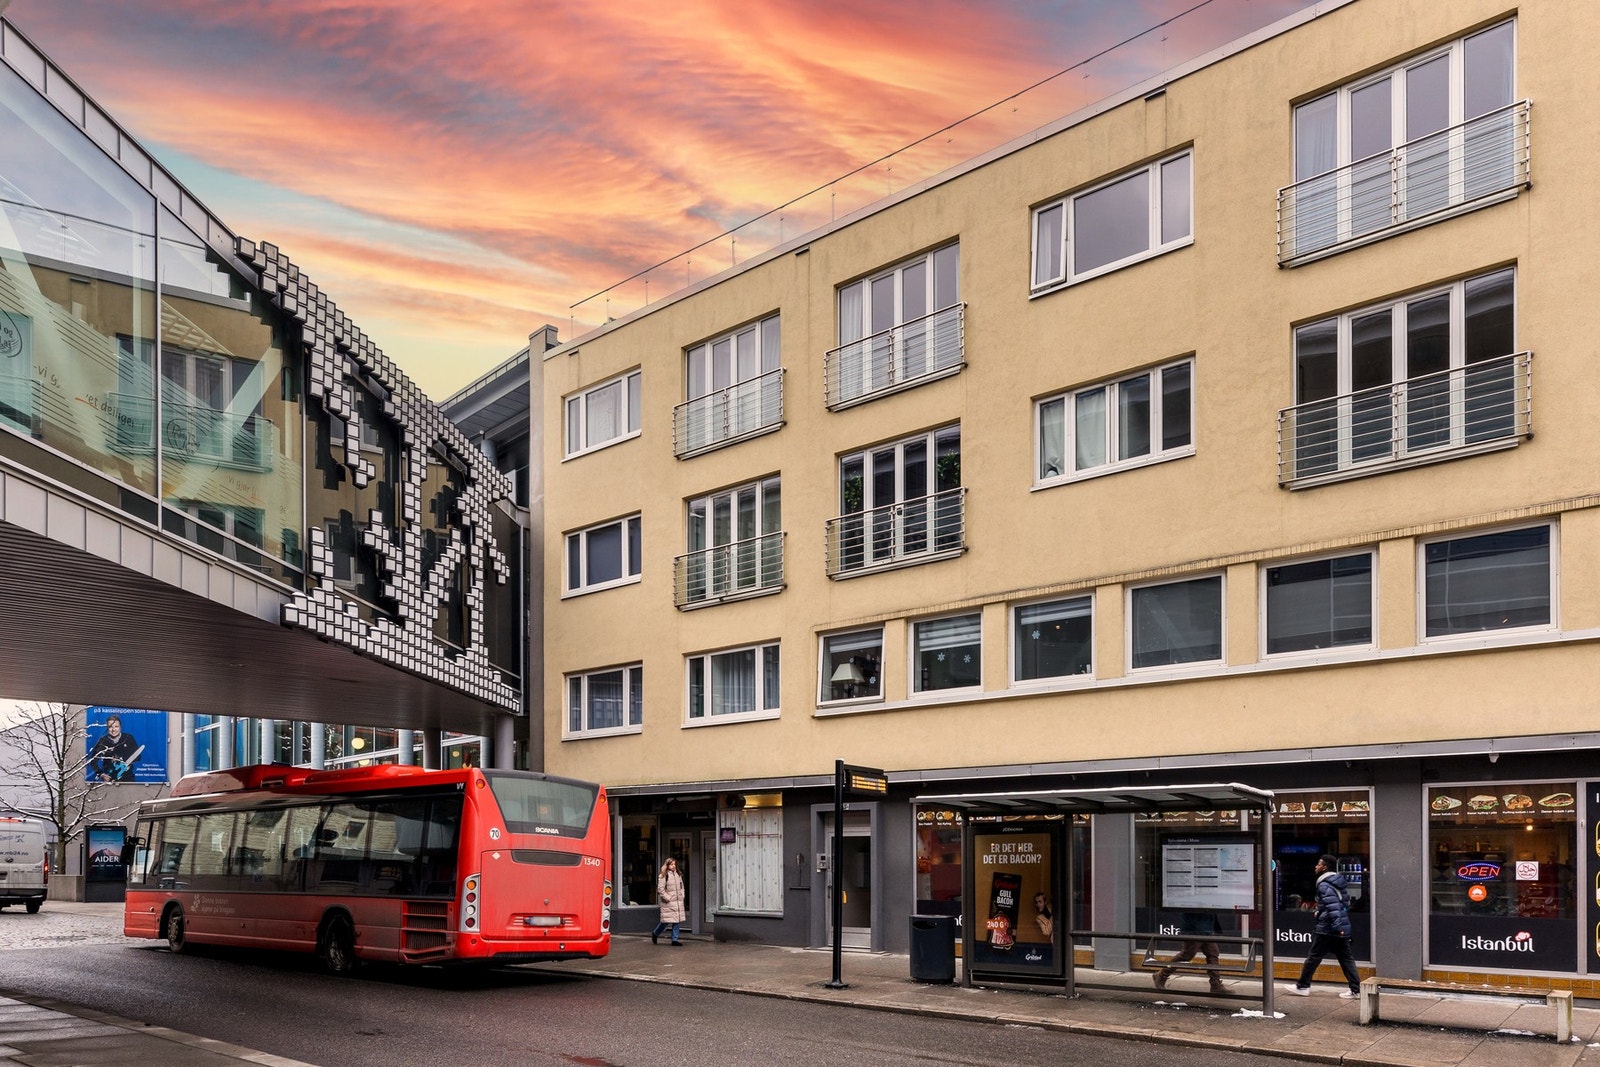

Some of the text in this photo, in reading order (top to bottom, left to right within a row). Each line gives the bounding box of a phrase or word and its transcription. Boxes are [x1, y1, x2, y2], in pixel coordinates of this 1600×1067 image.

[491, 829, 500, 838] 70
[535, 826, 560, 835] SCANIA
[990, 842, 1033, 852] ER DET HER
[94, 855, 120, 863] AIDER
[583, 857, 600, 867] 1340
[983, 854, 1042, 864] DET ER BACON?
[1457, 866, 1500, 877] OPEN
[996, 896, 1013, 905] BACON
[1159, 924, 1180, 935] Ista
[1276, 928, 1312, 943] Istan
[1461, 934, 1535, 953] Istanbul
